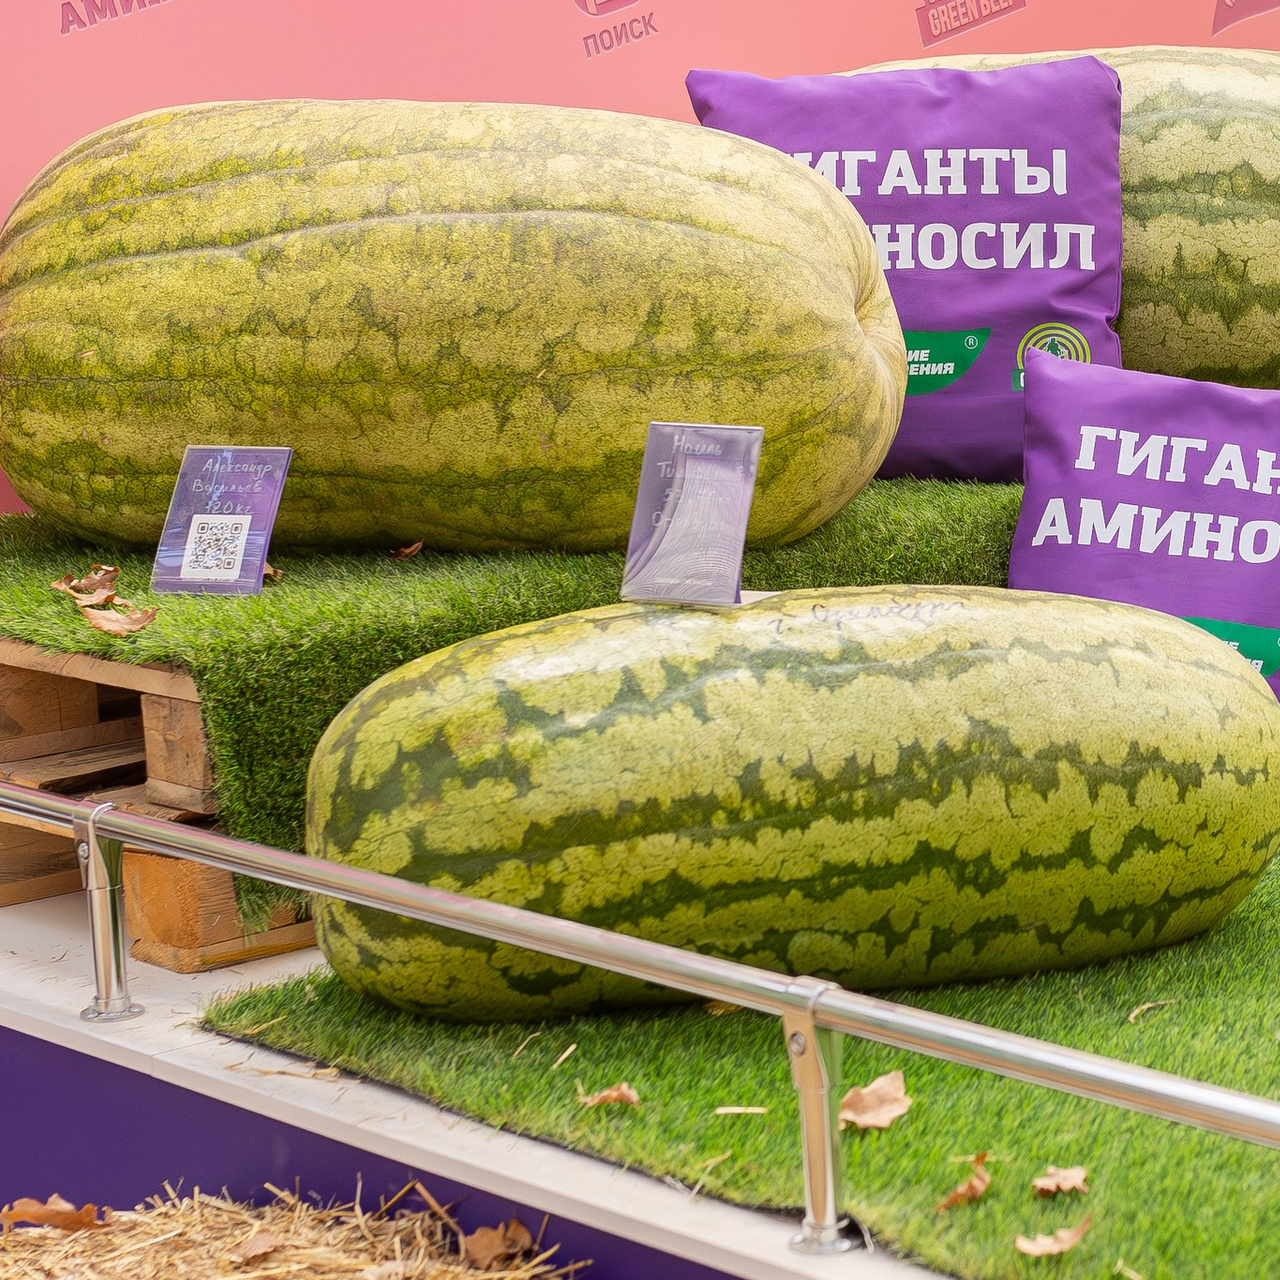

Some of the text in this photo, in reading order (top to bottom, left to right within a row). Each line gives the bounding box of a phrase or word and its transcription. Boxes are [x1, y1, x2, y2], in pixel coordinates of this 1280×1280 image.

[583, 12, 660, 59] ПОИСК
[790, 148, 1068, 196] ИГАНТЫ
[872, 222, 1096, 270] НОСИЛ
[202, 458, 273, 480] Александр
